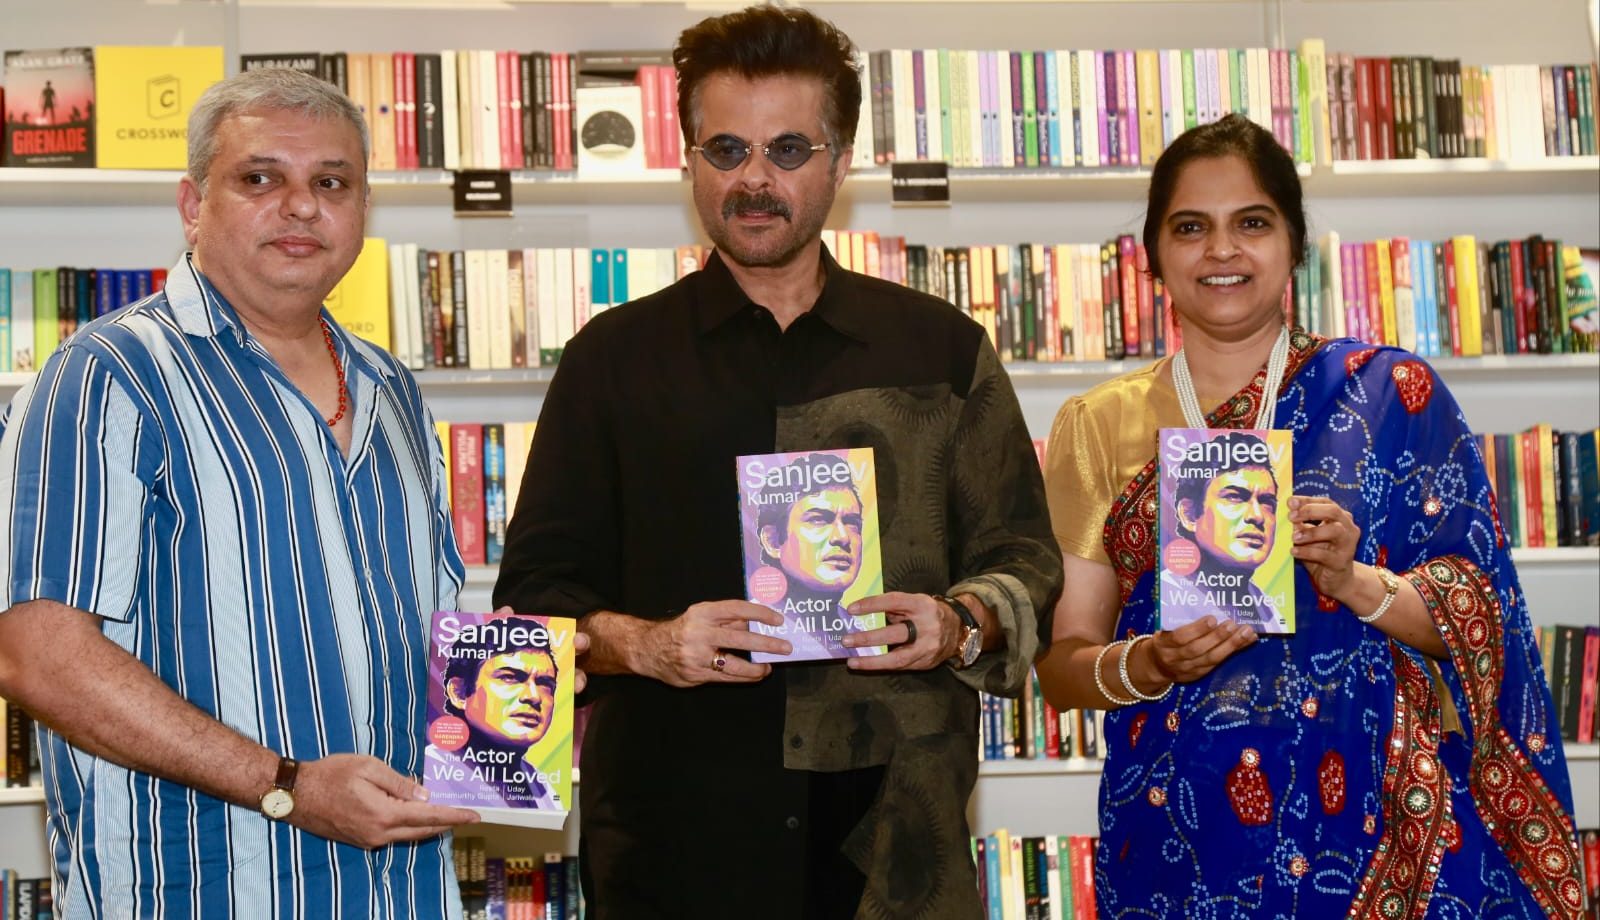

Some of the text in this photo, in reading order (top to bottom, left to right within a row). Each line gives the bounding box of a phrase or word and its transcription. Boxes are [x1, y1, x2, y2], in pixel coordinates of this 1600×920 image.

[13, 128, 87, 155] GRENADE
[116, 128, 189, 140] CROSSWO
[1166, 434, 1285, 470] Sanjeev
[745, 455, 867, 492] Sanjeev
[1167, 463, 1219, 479] Kumar
[747, 491, 800, 506] Kumar
[1195, 570, 1244, 587] Actor
[784, 598, 832, 613] Actor
[1169, 590, 1286, 607] We All Loved
[793, 616, 816, 633] All
[822, 613, 876, 632] Loved
[438, 616, 568, 651] Sanjeev
[829, 634, 842, 642] Uda
[437, 644, 494, 660] Kumar
[444, 747, 516, 764] The Actor
[433, 765, 561, 784] We All Loved
[507, 785, 526, 794] Uday
